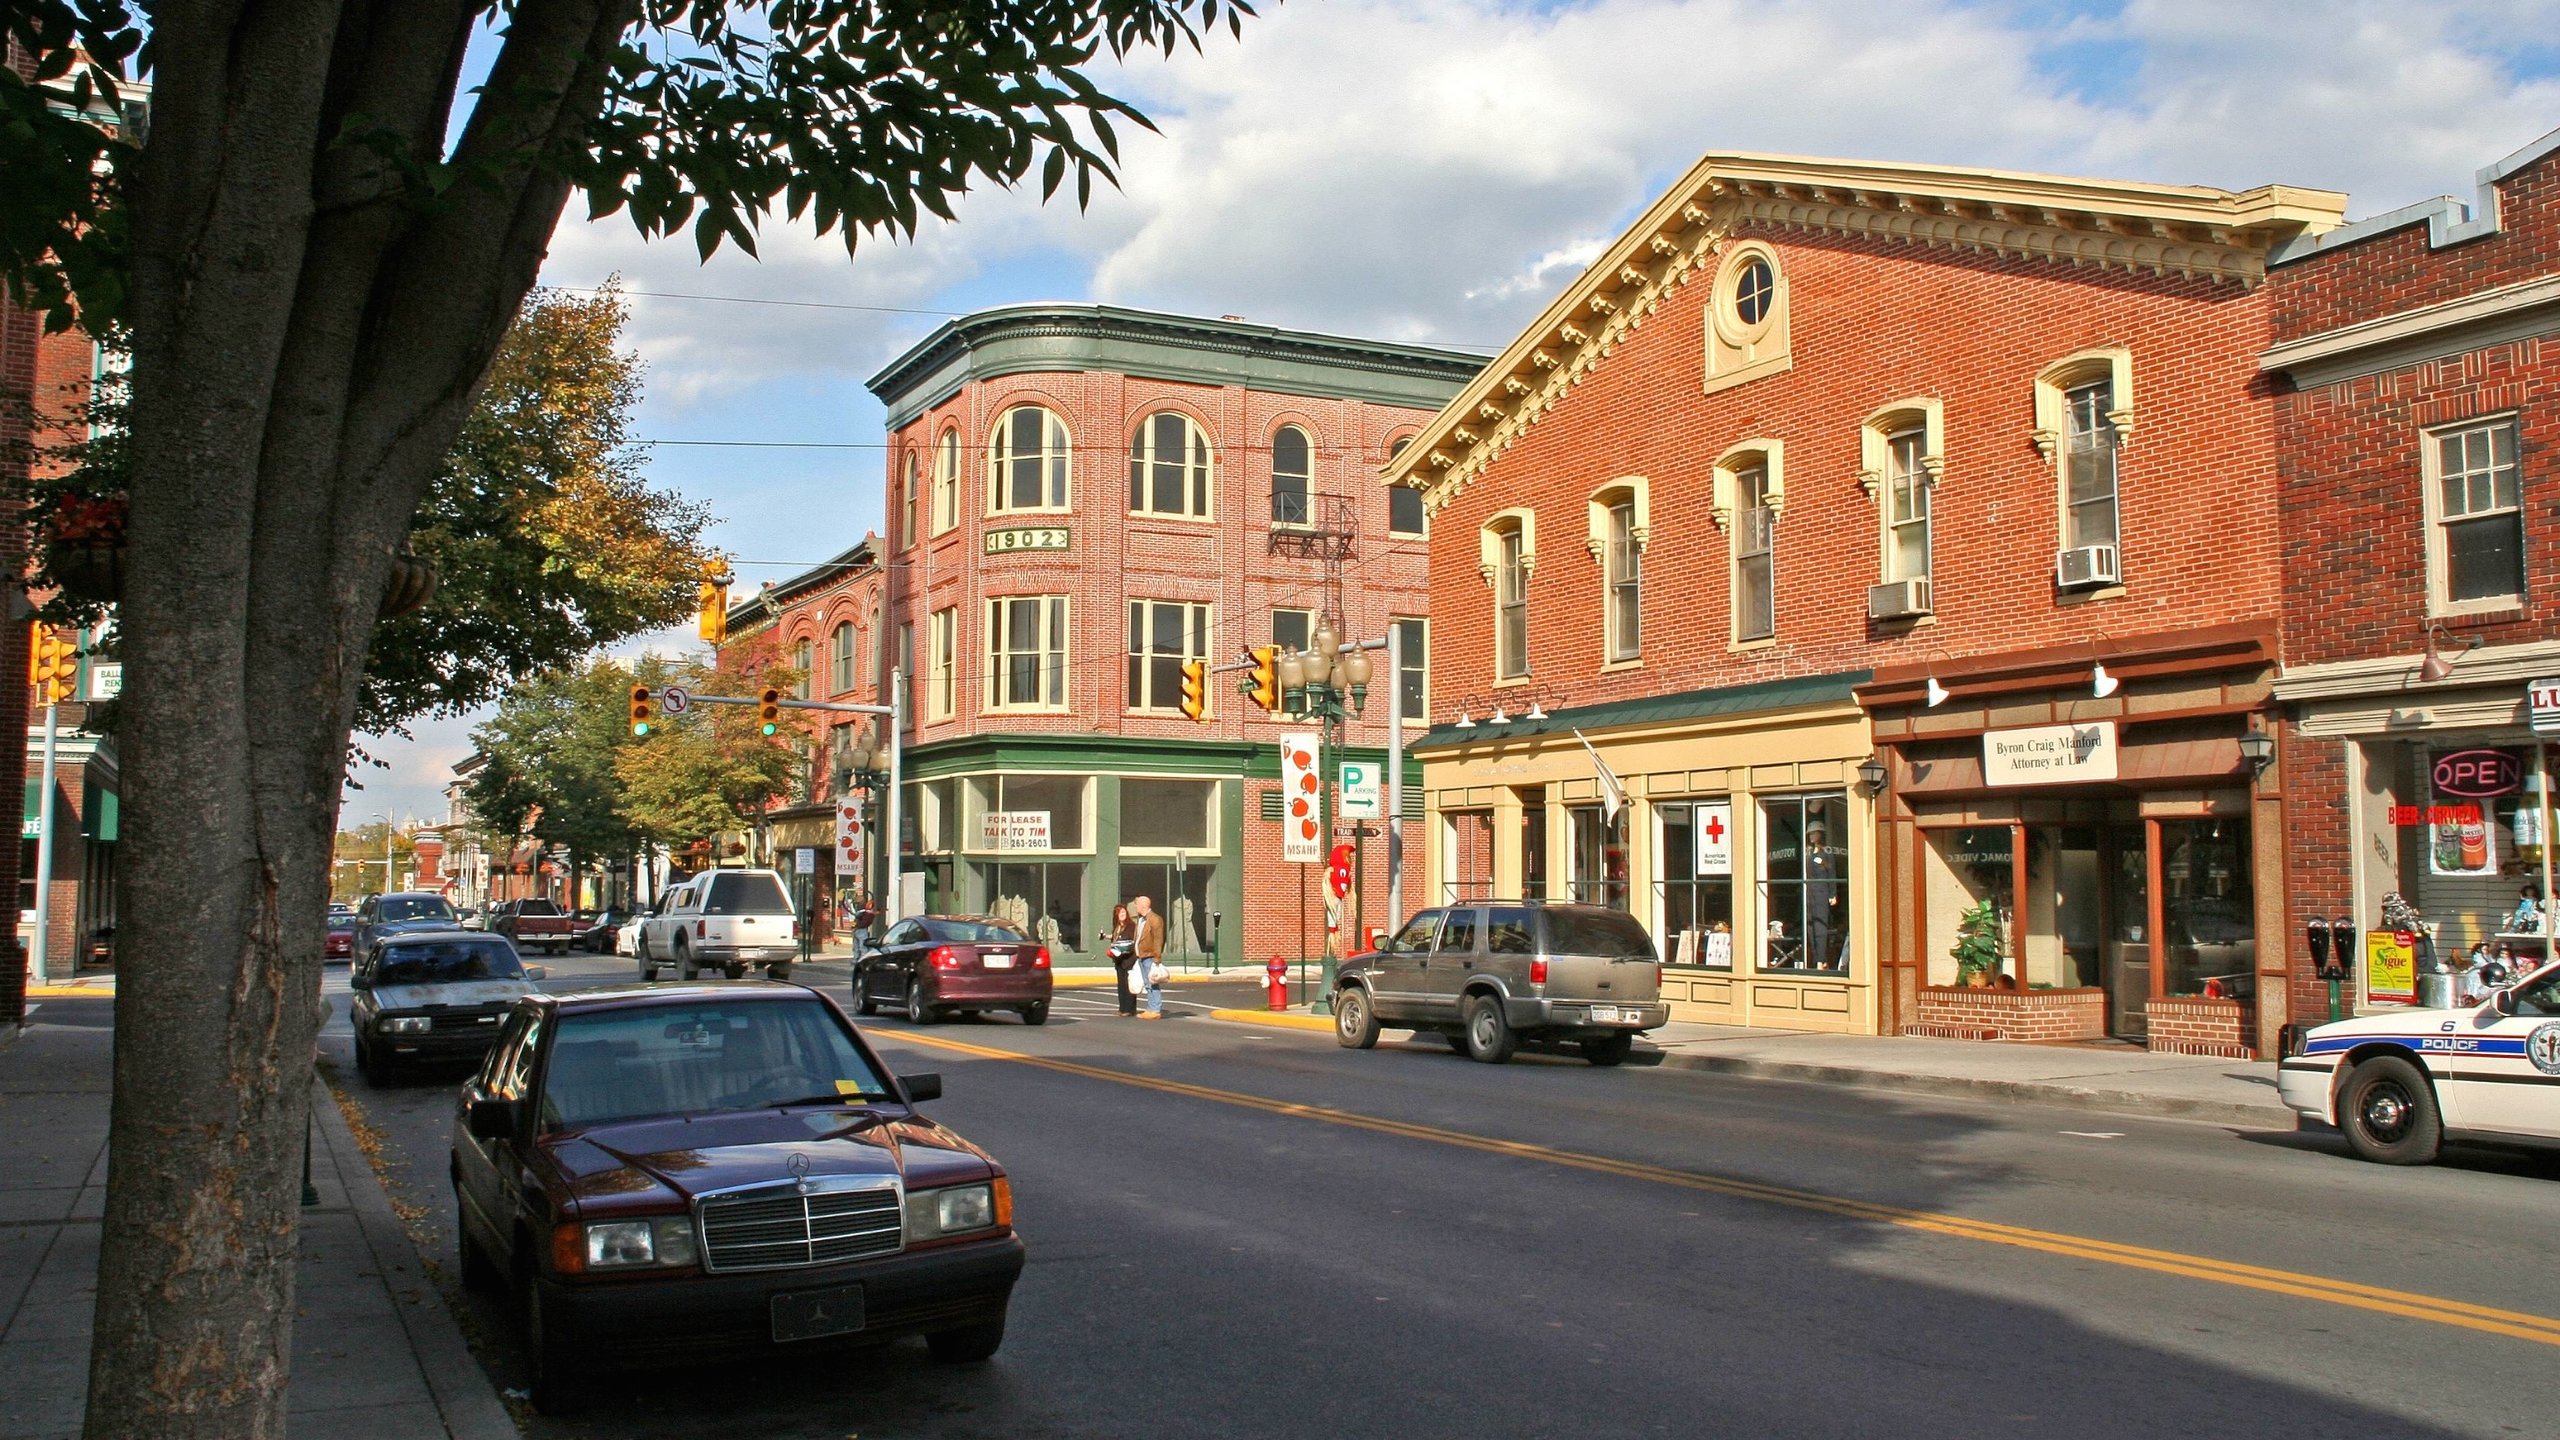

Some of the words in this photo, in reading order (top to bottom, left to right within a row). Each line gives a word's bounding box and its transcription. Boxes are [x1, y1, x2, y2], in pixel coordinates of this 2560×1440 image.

[995, 531, 1053, 550] 1902
[1996, 742, 2024, 757] Byron
[2027, 739, 2054, 752] Craig
[2059, 735, 2102, 749] Manford
[2010, 757, 2050, 769] Attorney
[2055, 756, 2064, 766] at
[2068, 754, 2088, 765] Law
[2434, 761, 2520, 786] OPEN
[988, 816, 1007, 824] FOR
[1011, 816, 1043, 824] LEASE
[2388, 806, 2418, 826] BEER
[1012, 828, 1025, 837] TO
[1030, 828, 1046, 837] TIM
[2375, 947, 2407, 970] Sigue
[2441, 1020, 2456, 1032] 6
[2422, 1039, 2479, 1051] POLICE
